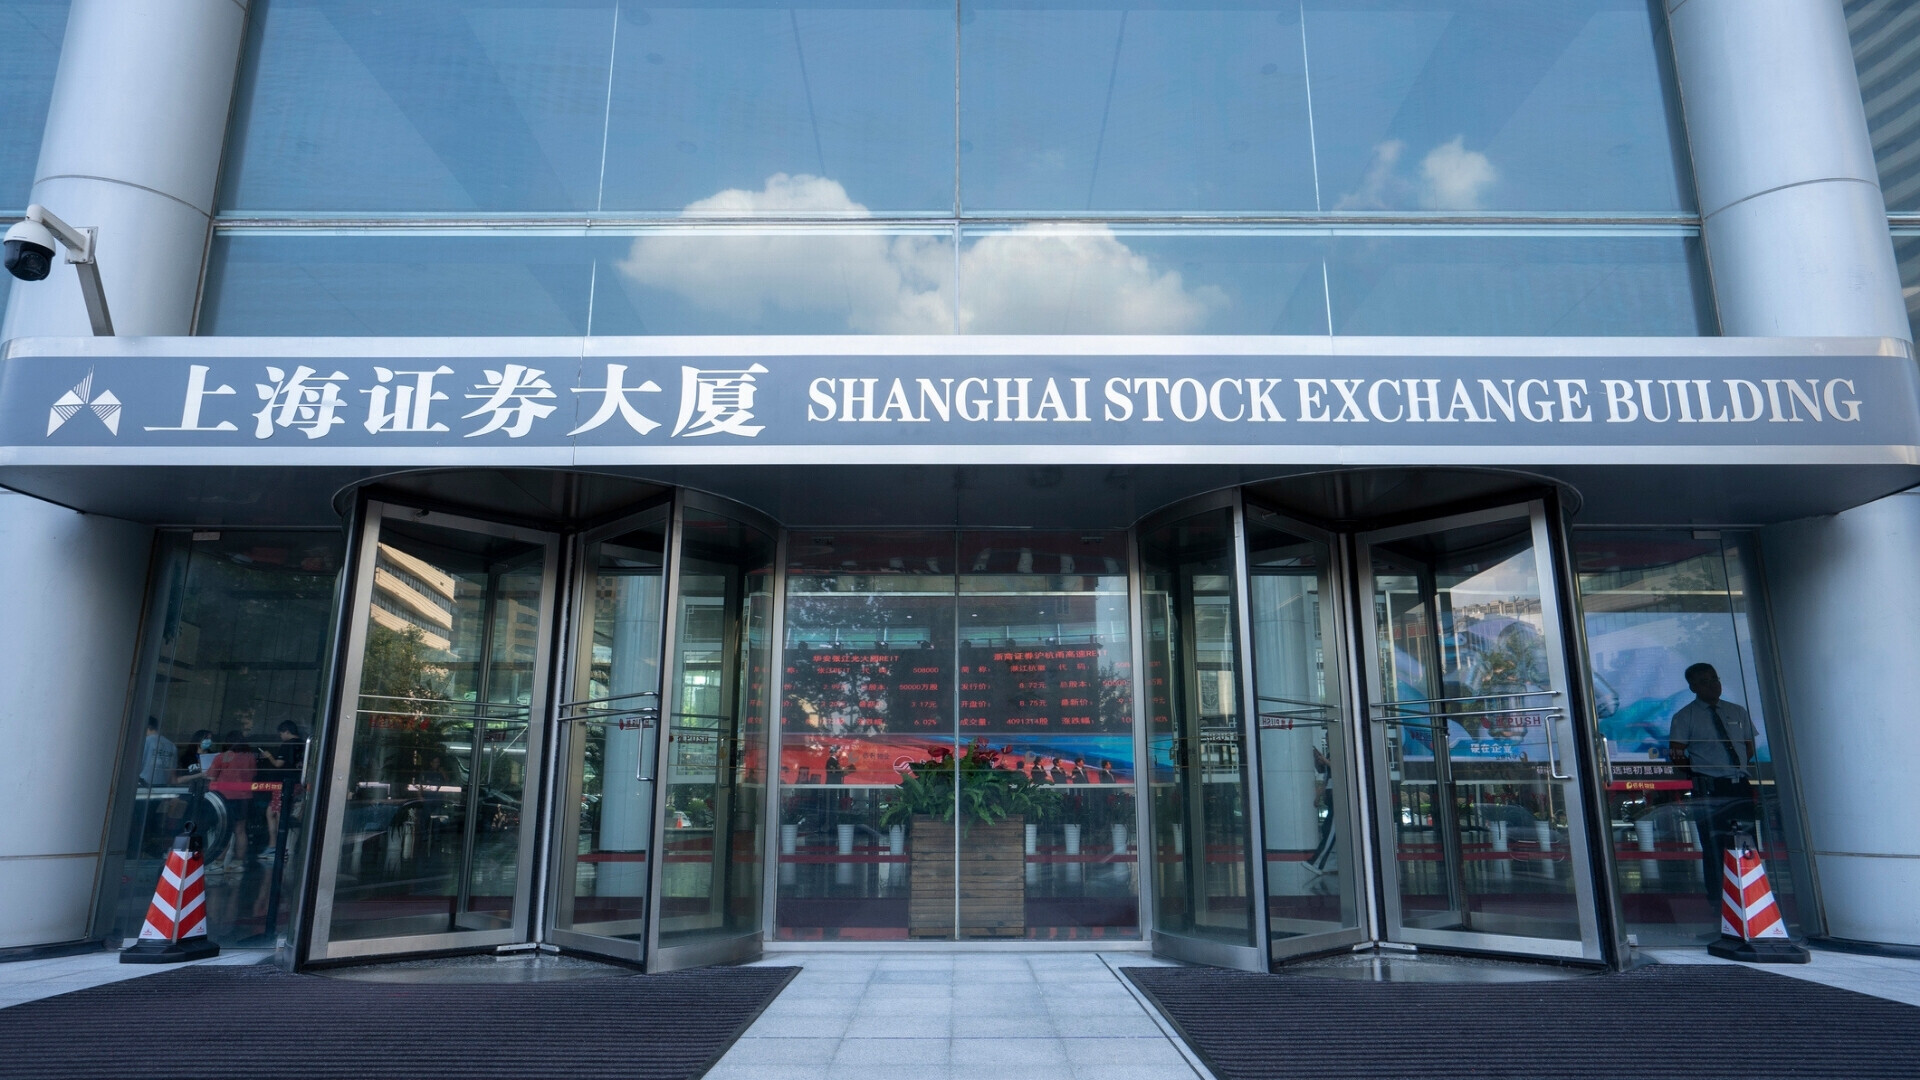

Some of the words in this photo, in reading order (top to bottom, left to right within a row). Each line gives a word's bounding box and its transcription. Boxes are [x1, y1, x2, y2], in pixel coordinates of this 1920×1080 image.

[144, 363, 769, 439] 上海证券大厦
[808, 377, 1091, 423] SHANGHAI
[1104, 377, 1287, 423] STOCK
[1296, 378, 1593, 423] EXCHANGE
[1606, 378, 1863, 423] BUILDING
[1507, 715, 1541, 727] PUSH
